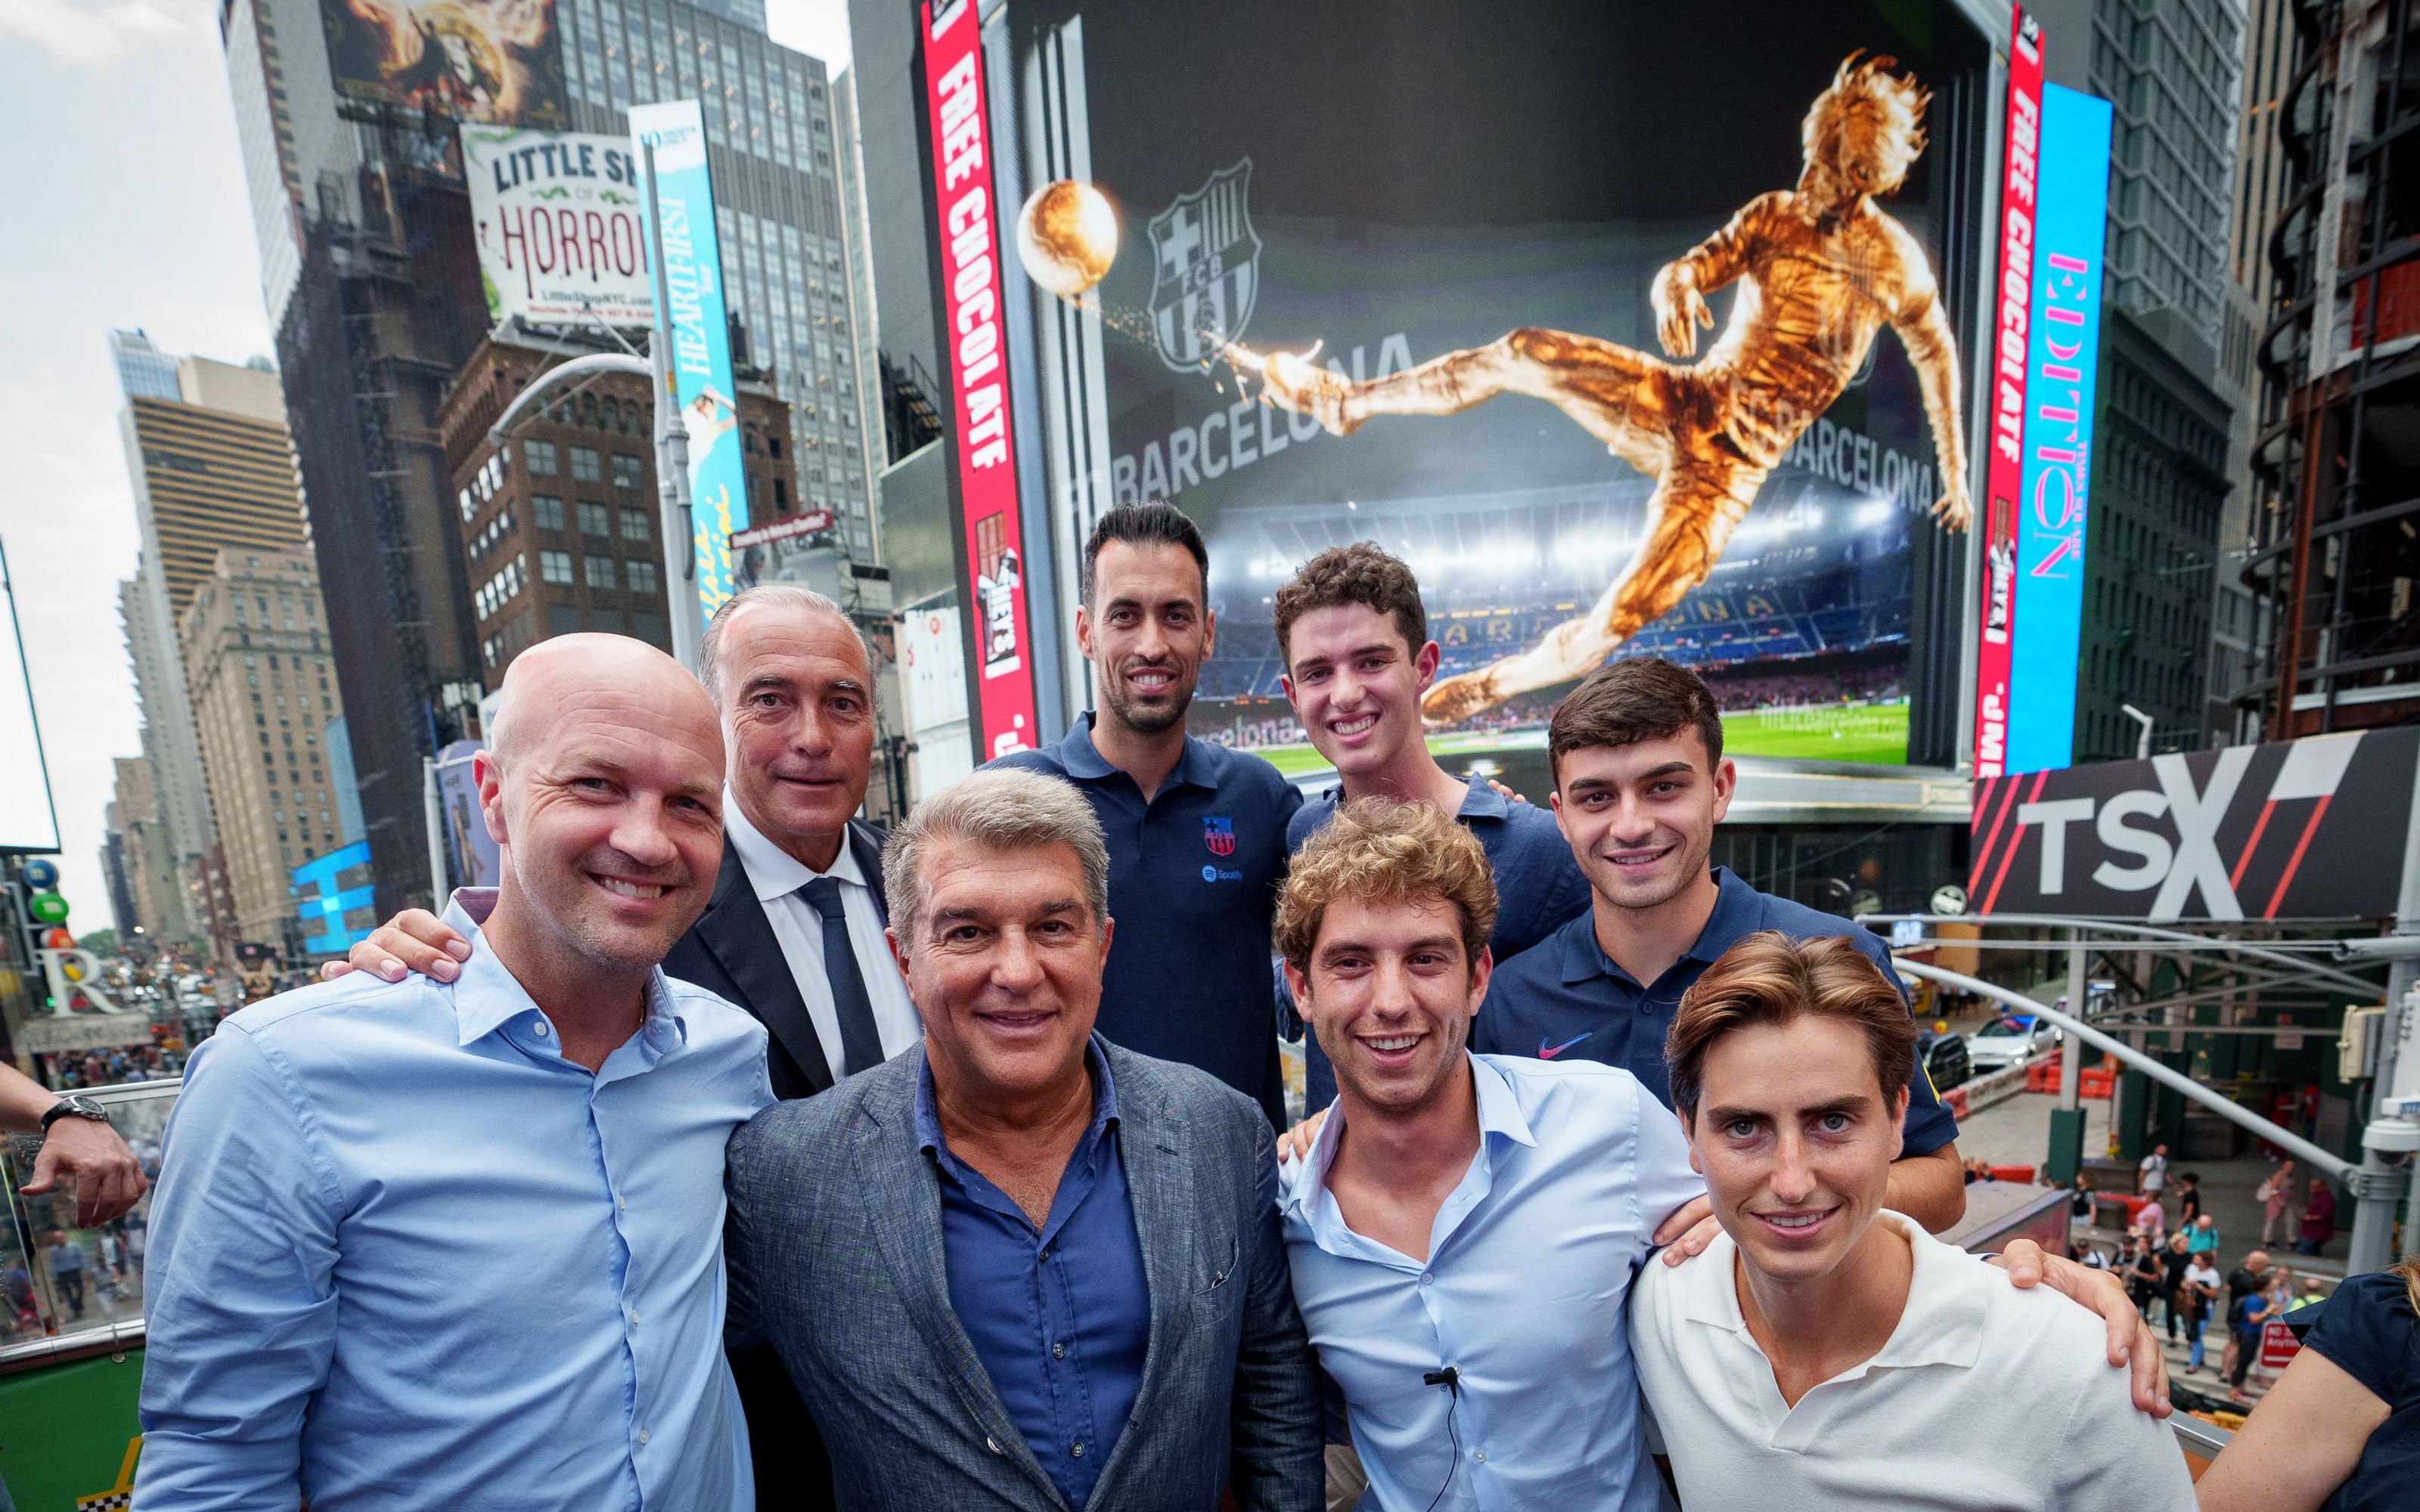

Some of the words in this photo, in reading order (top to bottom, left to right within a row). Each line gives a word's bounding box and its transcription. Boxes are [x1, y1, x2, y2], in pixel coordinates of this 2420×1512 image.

[493, 143, 597, 193] LITTLE
[938, 51, 982, 191] FREE
[2009, 87, 2037, 206] FREE
[498, 204, 648, 299] HORRO
[1181, 253, 1224, 296] FCB
[948, 186, 1007, 469] CHOCOLATE
[1997, 207, 2031, 463] CHOCOLATE
[2030, 252, 2088, 581] EDITION
[1218, 869, 1243, 881] Spotify
[2017, 745, 2257, 924] TSX
[32, 947, 126, 1018] R
[2268, 1327, 2282, 1336] NO
